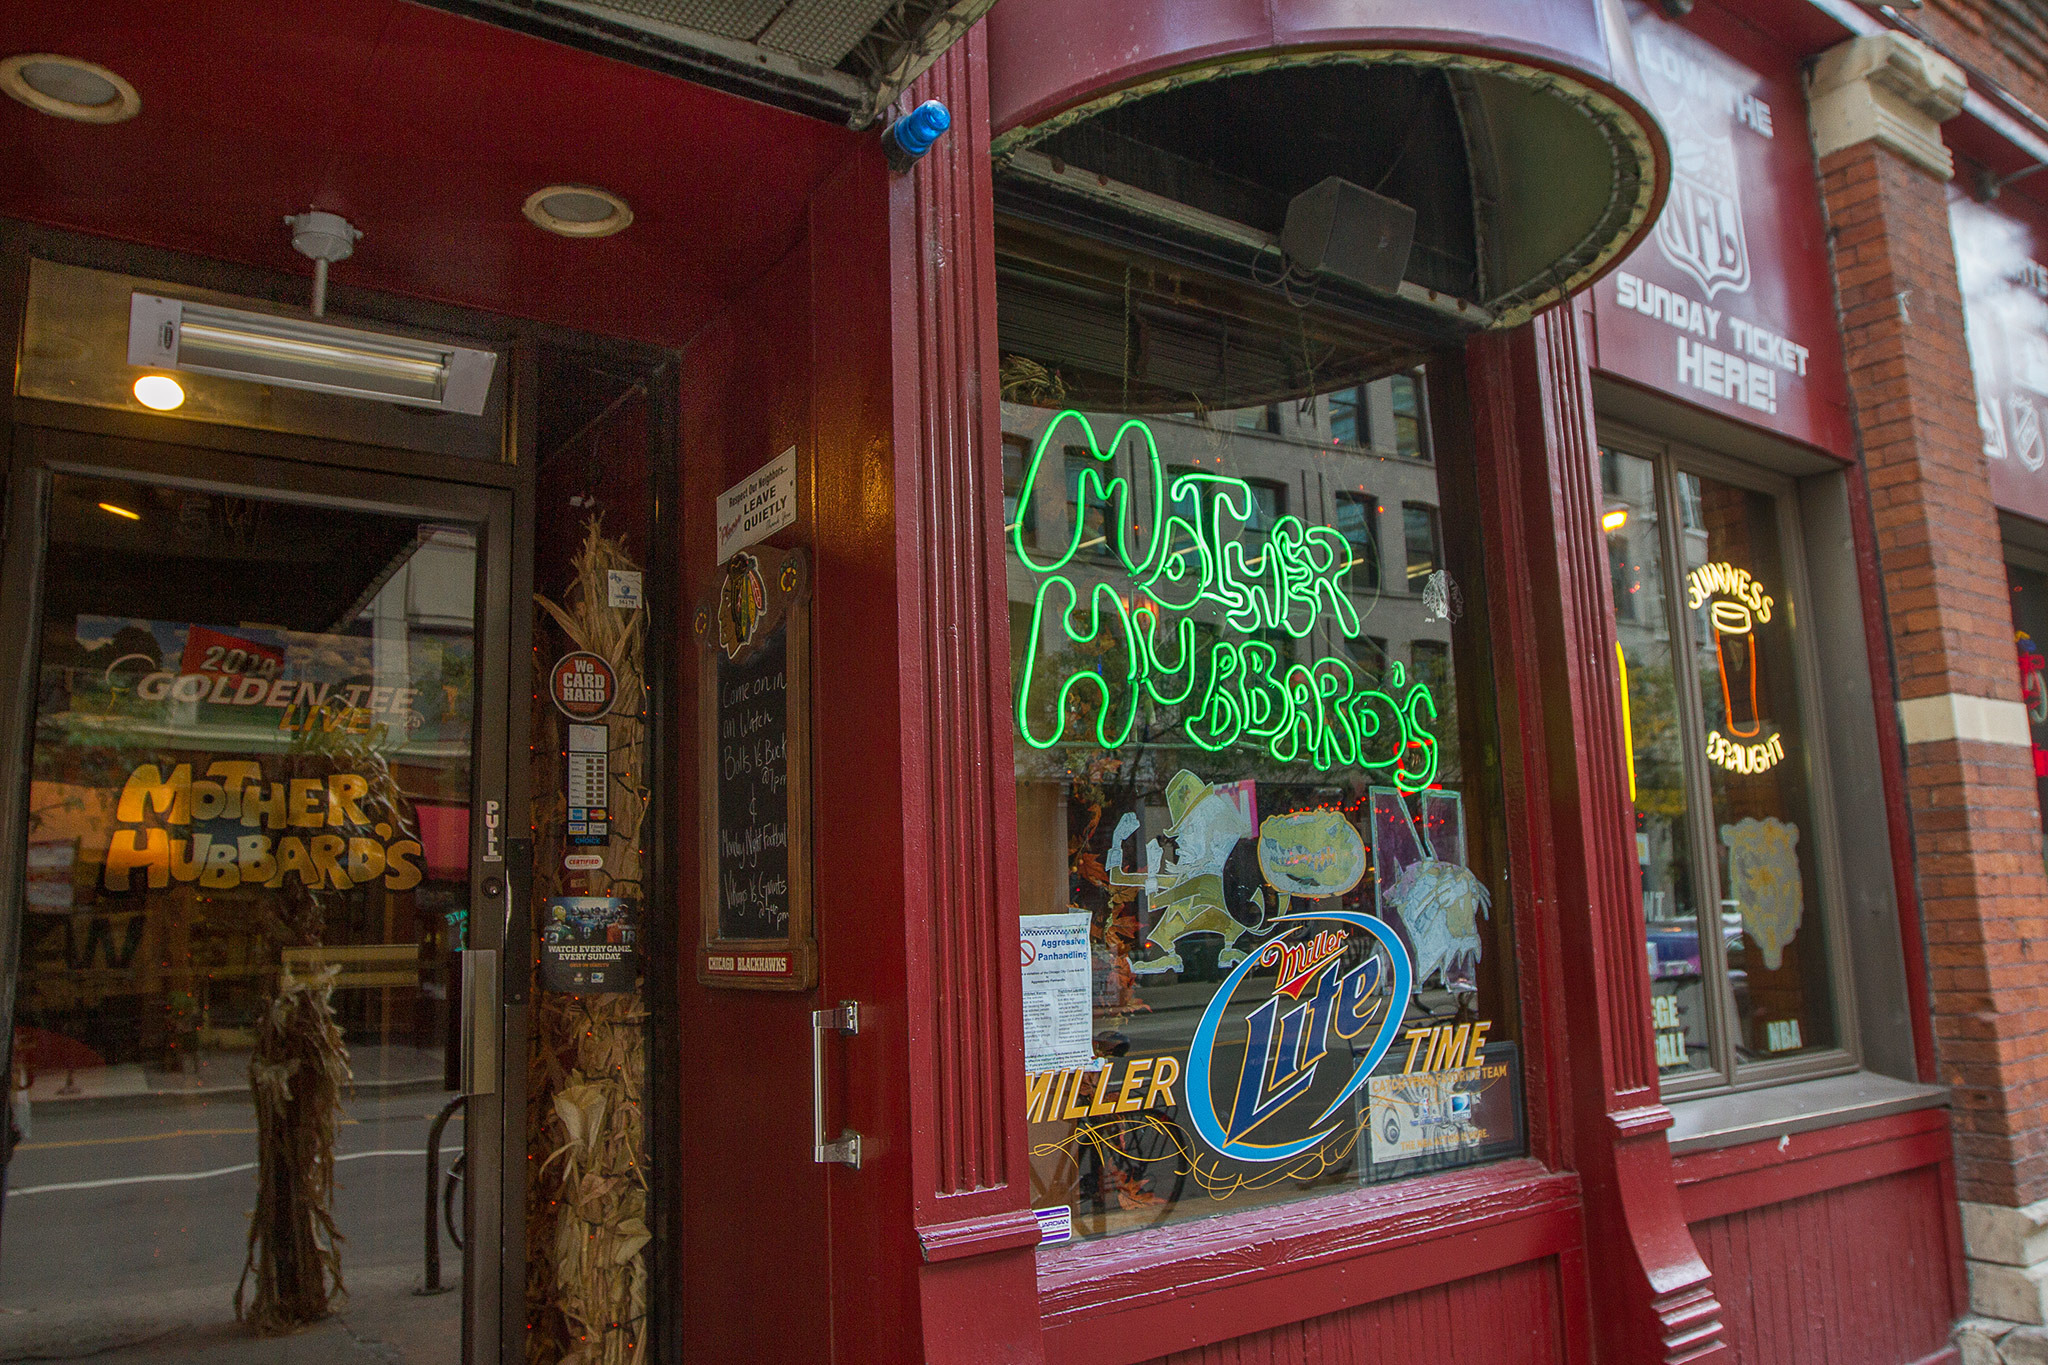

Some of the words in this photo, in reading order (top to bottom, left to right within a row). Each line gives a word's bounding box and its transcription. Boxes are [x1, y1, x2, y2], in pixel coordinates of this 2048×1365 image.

[1616, 270, 1722, 342] SUNDAY
[1728, 316, 1809, 377] TICKET
[1677, 335, 1777, 415] HERE!
[744, 485, 776, 515] LEAVE
[744, 495, 787, 532] QUIETLY
[1014, 409, 1361, 639] MOTHER
[1686, 561, 1774, 624] GUINNESS
[562, 672, 606, 689] CARD
[574, 659, 595, 673] We
[1019, 575, 1439, 793] HUBBARD'S
[136, 671, 330, 708] GOLDEN
[343, 684, 419, 715] TEE
[563, 687, 606, 703] HARD
[722, 681, 750, 708] Come
[753, 676, 771, 695] on
[773, 672, 787, 690] in
[278, 703, 375, 734] LIVE
[1706, 730, 1784, 775] DRAUGHT
[116, 760, 370, 830] MOTHER
[485, 800, 499, 856] PULL
[104, 822, 424, 891] HUBBARD'S
[548, 945, 578, 953] WATCH
[579, 945, 607, 953] EVERY
[607, 945, 632, 953] GAME.
[558, 953, 587, 961] EVERY
[1038, 951, 1087, 961] Panhandling
[1041, 938, 1086, 949] Aggressive
[1260, 929, 1350, 989] Miller
[708, 956, 734, 971] CHICAGO
[737, 957, 787, 972] BLACKHAWKS
[1222, 953, 1383, 1149] Lite
[1403, 1021, 1492, 1075] TIME
[1767, 1019, 1803, 1052] NBA
[1025, 1056, 1180, 1124] MILLER
[1372, 1079, 1405, 1093] CATCH
[1481, 1065, 1508, 1080] TEAM
[1400, 1140, 1416, 1151] THE
